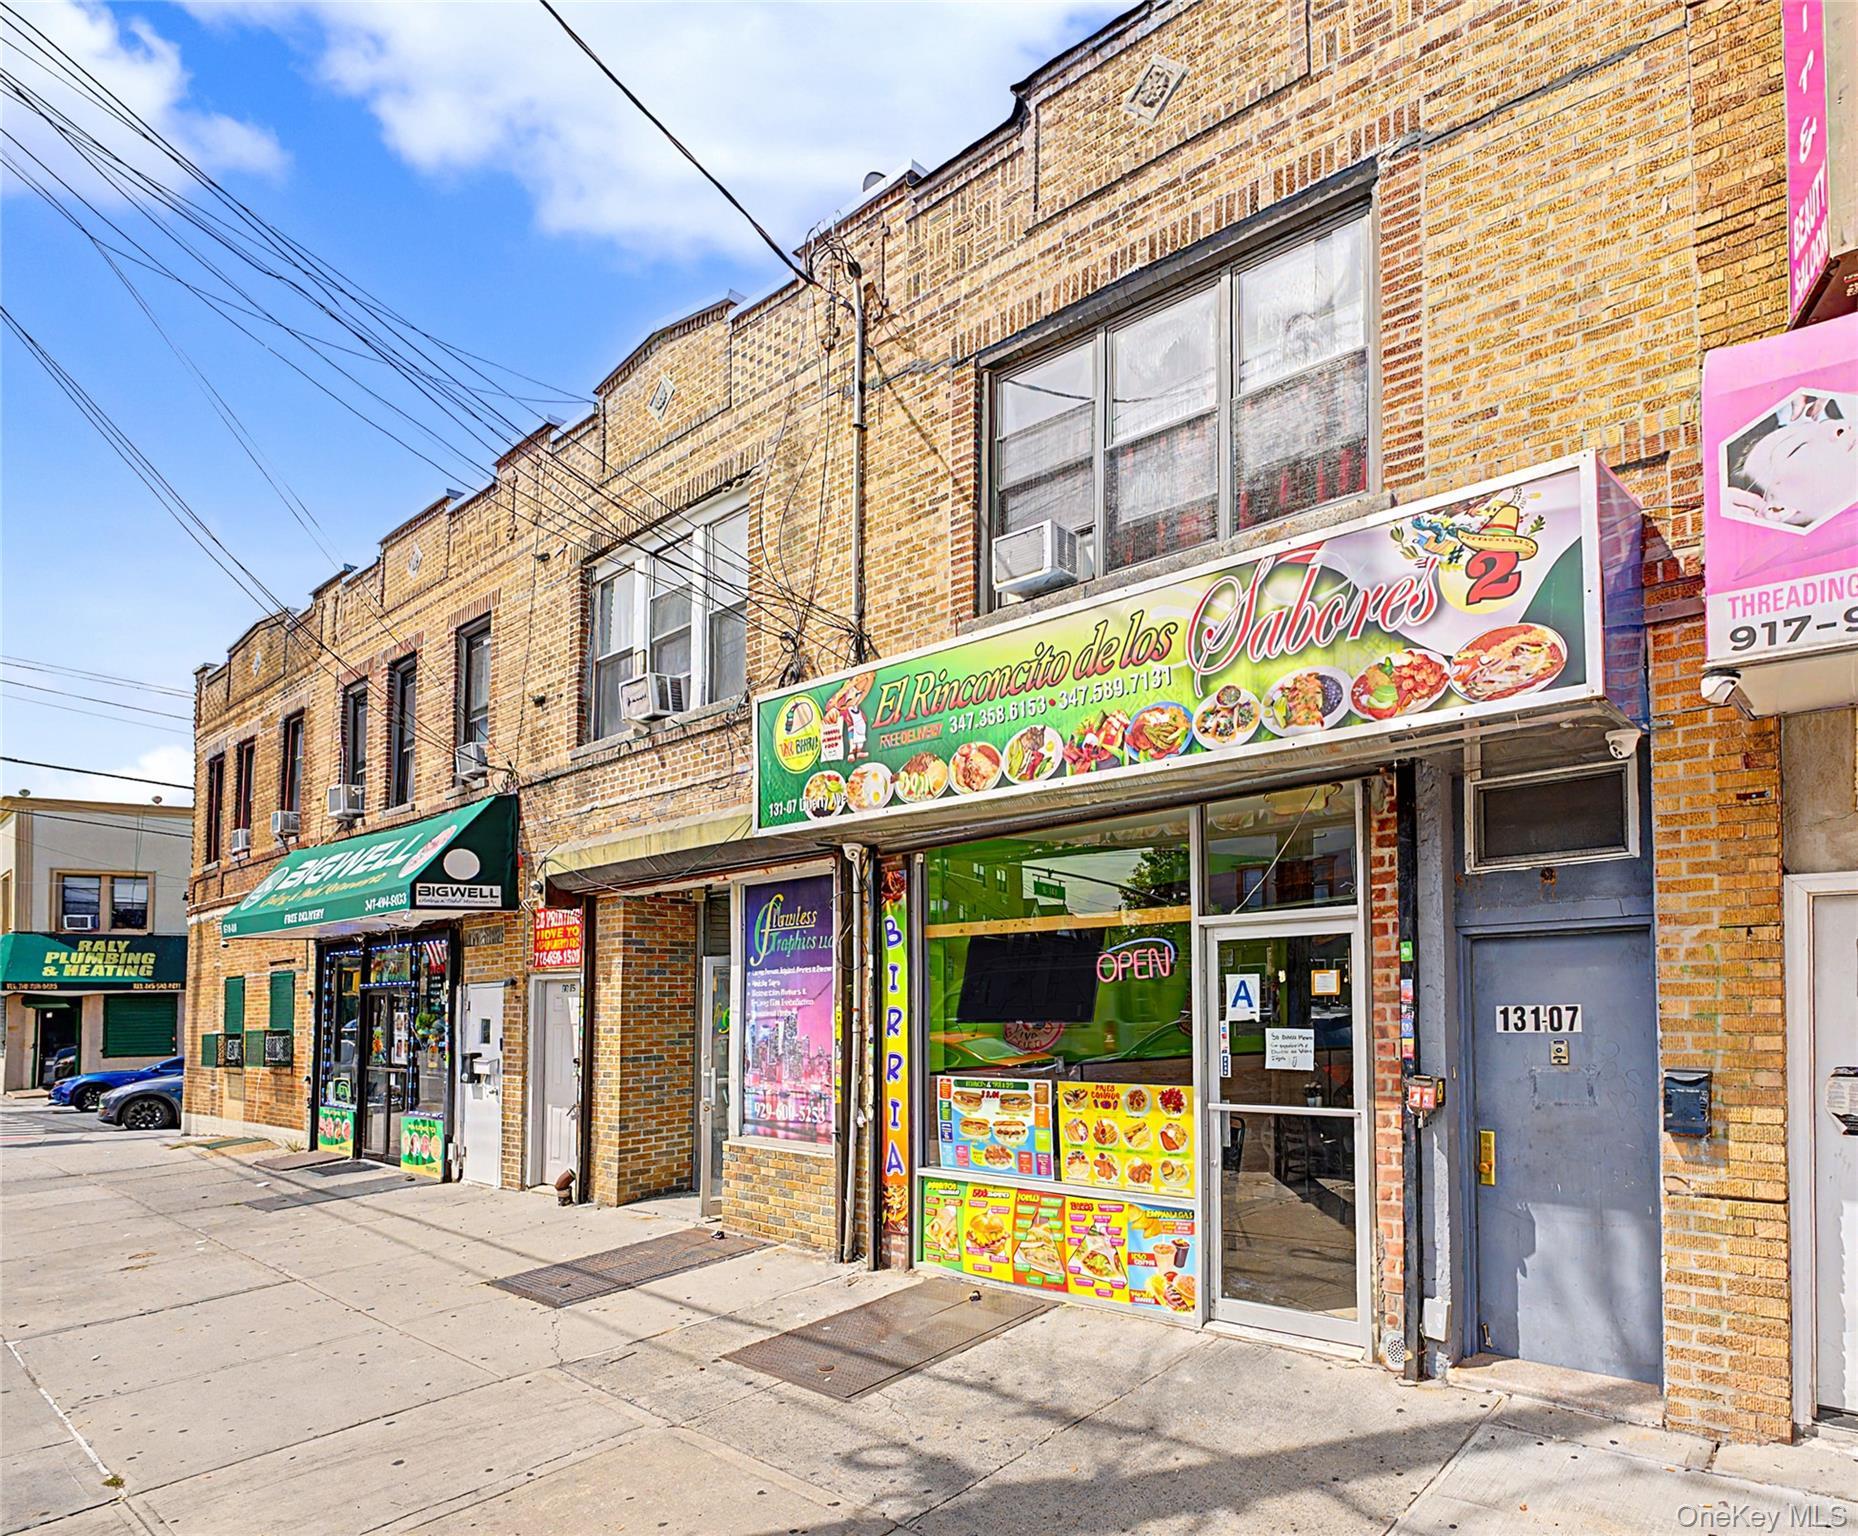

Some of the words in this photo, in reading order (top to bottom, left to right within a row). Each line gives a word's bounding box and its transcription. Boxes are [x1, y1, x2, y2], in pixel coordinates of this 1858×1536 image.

[1727, 573, 1858, 620] THREADING
[871, 673, 911, 730] El
[905, 641, 1072, 722] Rinconcito
[1072, 618, 1120, 681] de
[1118, 608, 1178, 671] los
[1465, 550, 1521, 606] 2
[1058, 666, 1173, 710] 347.589.7131
[275, 833, 424, 890] BIGWELL
[417, 885, 499, 898] BIGWELL
[45, 951, 157, 965] PLUMBING
[77, 940, 131, 953] RALY
[42, 965, 59, 977] &
[62, 963, 154, 977] HEATING
[1096, 946, 1171, 983] OPEN
[1231, 979, 1254, 1008] A
[1499, 1005, 1579, 1032] 131-07
[884, 914, 904, 1176] BIRRIA
